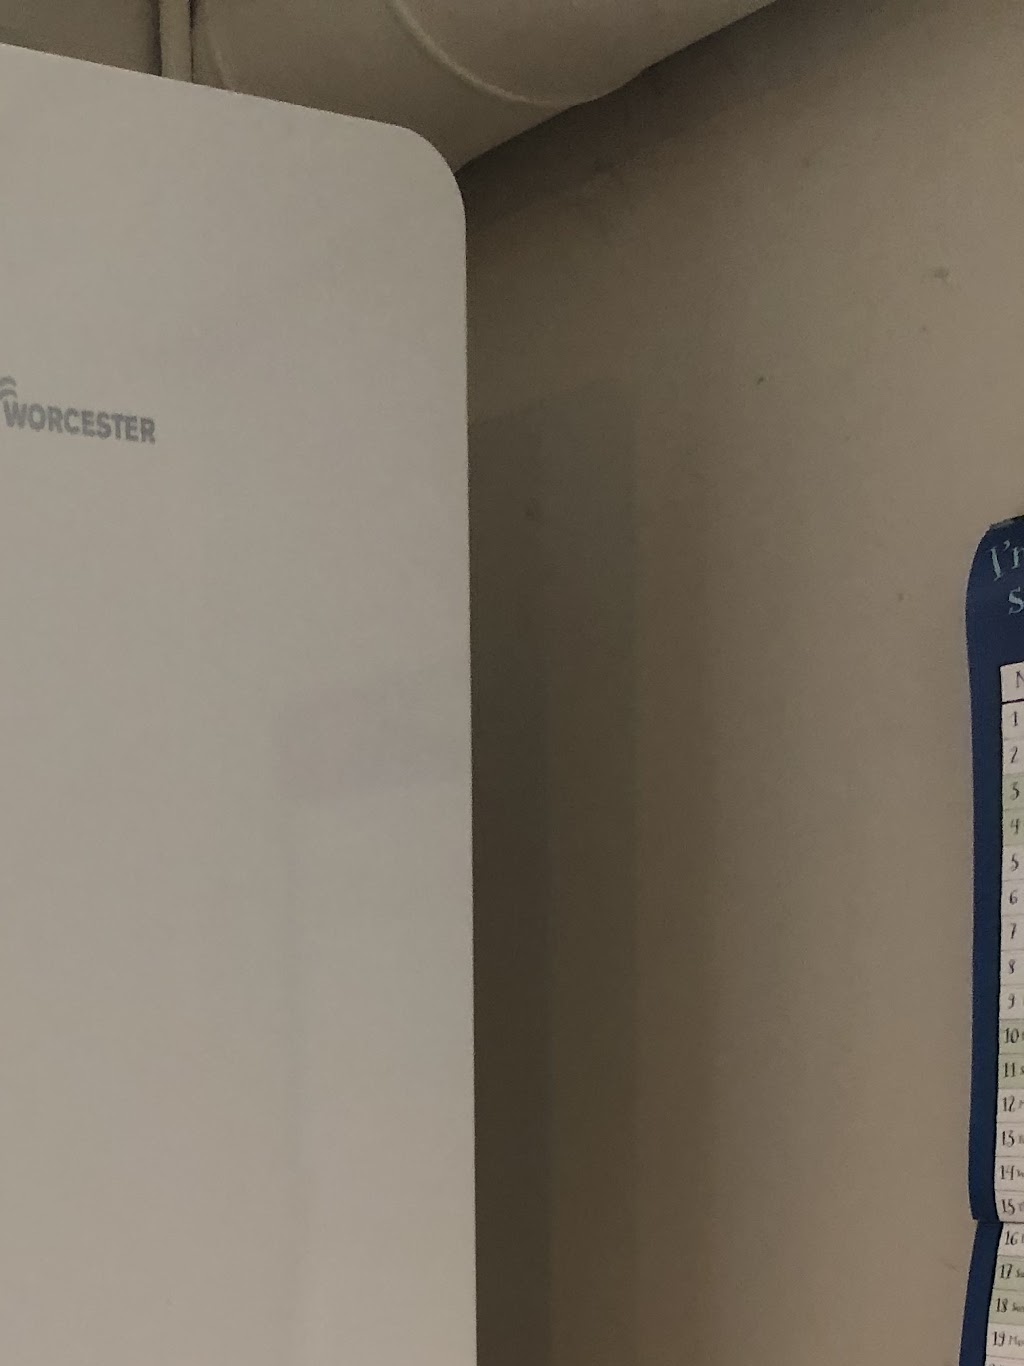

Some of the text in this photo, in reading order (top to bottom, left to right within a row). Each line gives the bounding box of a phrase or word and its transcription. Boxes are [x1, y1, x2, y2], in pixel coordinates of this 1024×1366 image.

[3, 400, 155, 443] WORCESTER
[1012, 711, 1018, 726] 1
[1010, 746, 1018, 763] 2
[1010, 781, 1020, 800] 3
[1010, 818, 1020, 835] 4
[1010, 853, 1019, 872] 5
[1009, 889, 1018, 905] 6
[1010, 922, 1017, 939] 7
[1004, 1028, 1019, 1044] 10
[1003, 1062, 1017, 1077] 11
[1003, 1095, 1016, 1112] 12
[1001, 1130, 1015, 1147] 13
[1000, 1165, 1015, 1180] 14
[1001, 1199, 1015, 1215] 15
[1005, 1230, 1018, 1245] 16
[1000, 1263, 1013, 1279] 17
[996, 1298, 1008, 1312] 18
[992, 1331, 1005, 1347] 19
